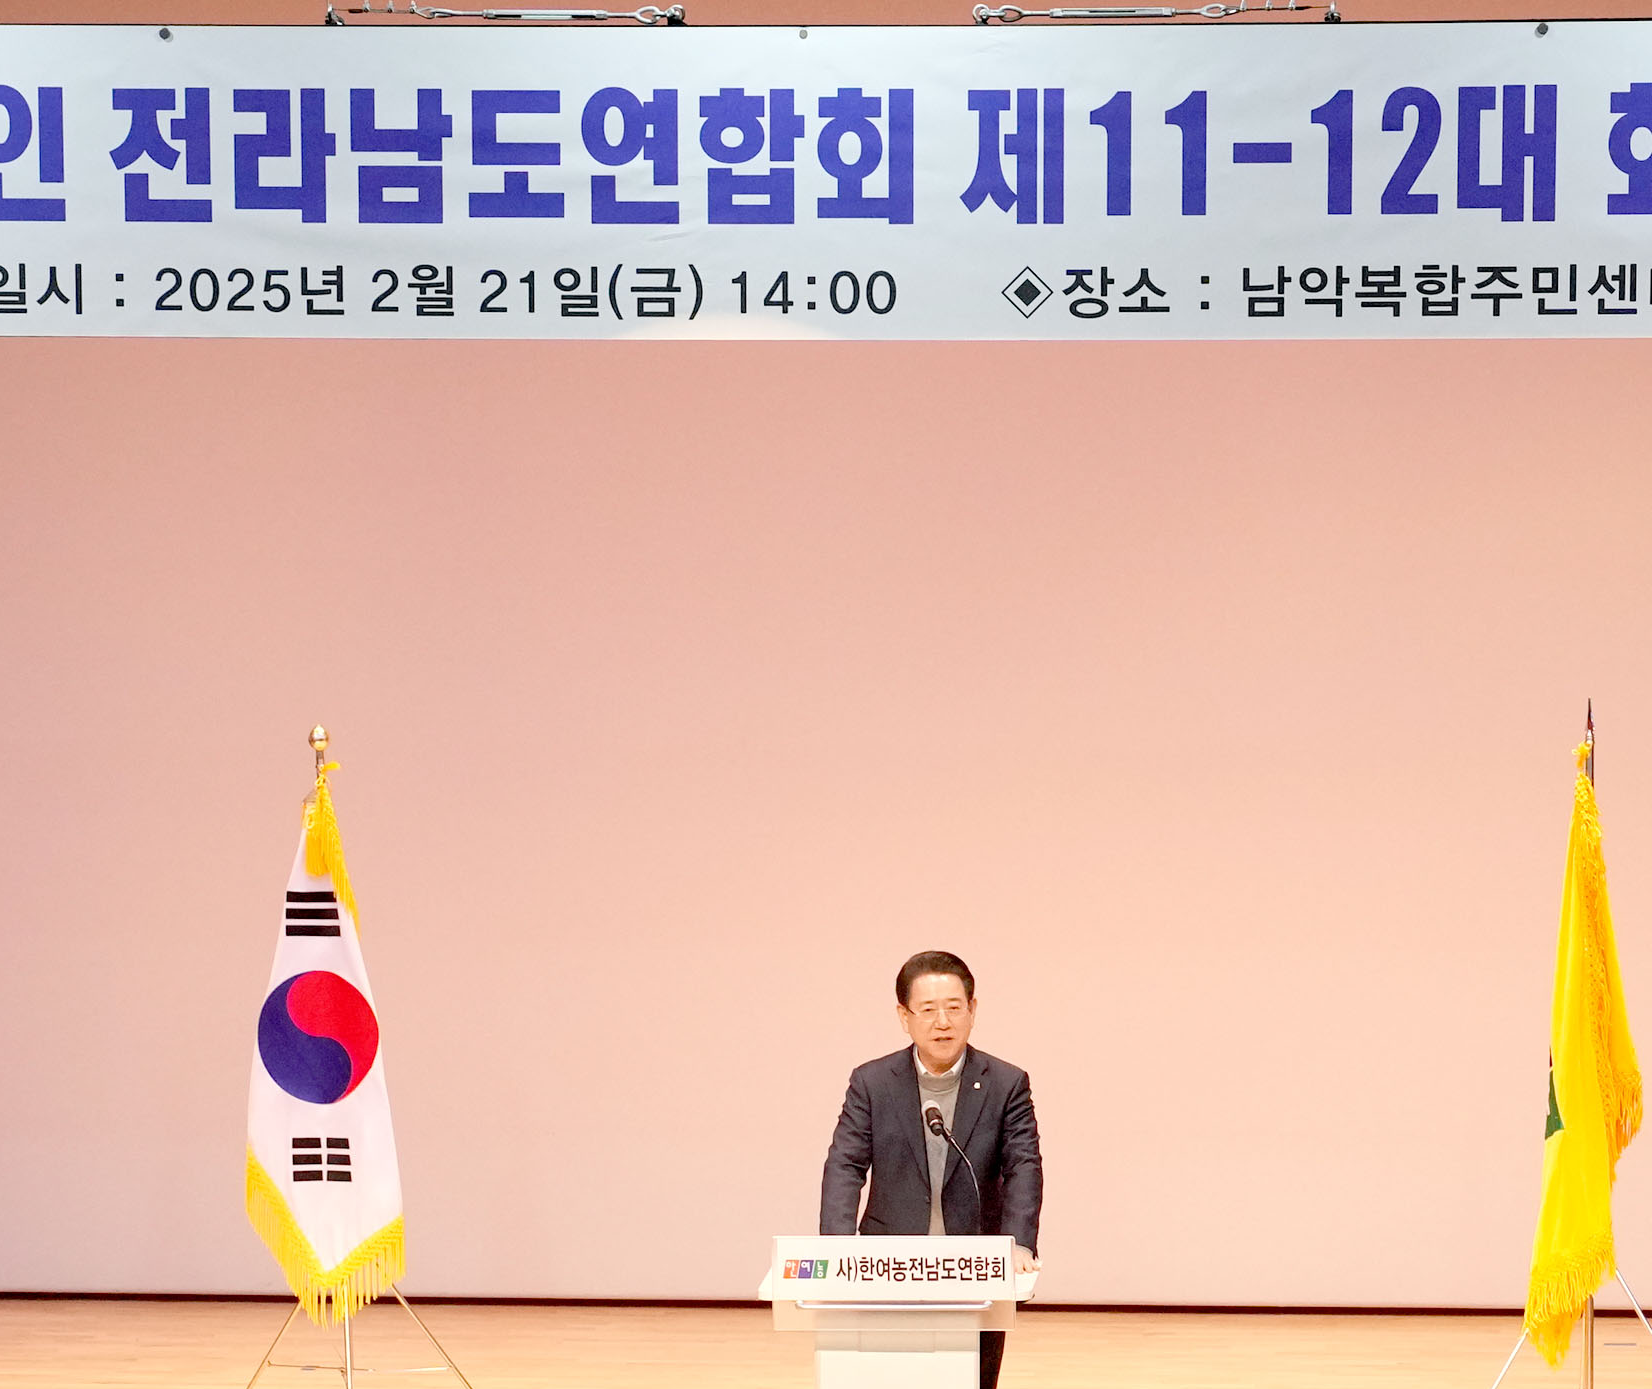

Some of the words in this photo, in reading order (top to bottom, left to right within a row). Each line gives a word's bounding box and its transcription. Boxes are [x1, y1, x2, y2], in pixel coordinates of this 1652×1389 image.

[109, 87, 914, 225] 전라남도연합회
[960, 84, 1557, 224] 제11-12대
[155, 265, 345, 316] 2025년
[371, 264, 455, 317] 2월
[479, 263, 703, 320] 21일(금)
[731, 270, 897, 315] 14:00
[1063, 266, 1170, 319] 장소
[836, 1256, 1007, 1283] 사)한여농전남도연합회
